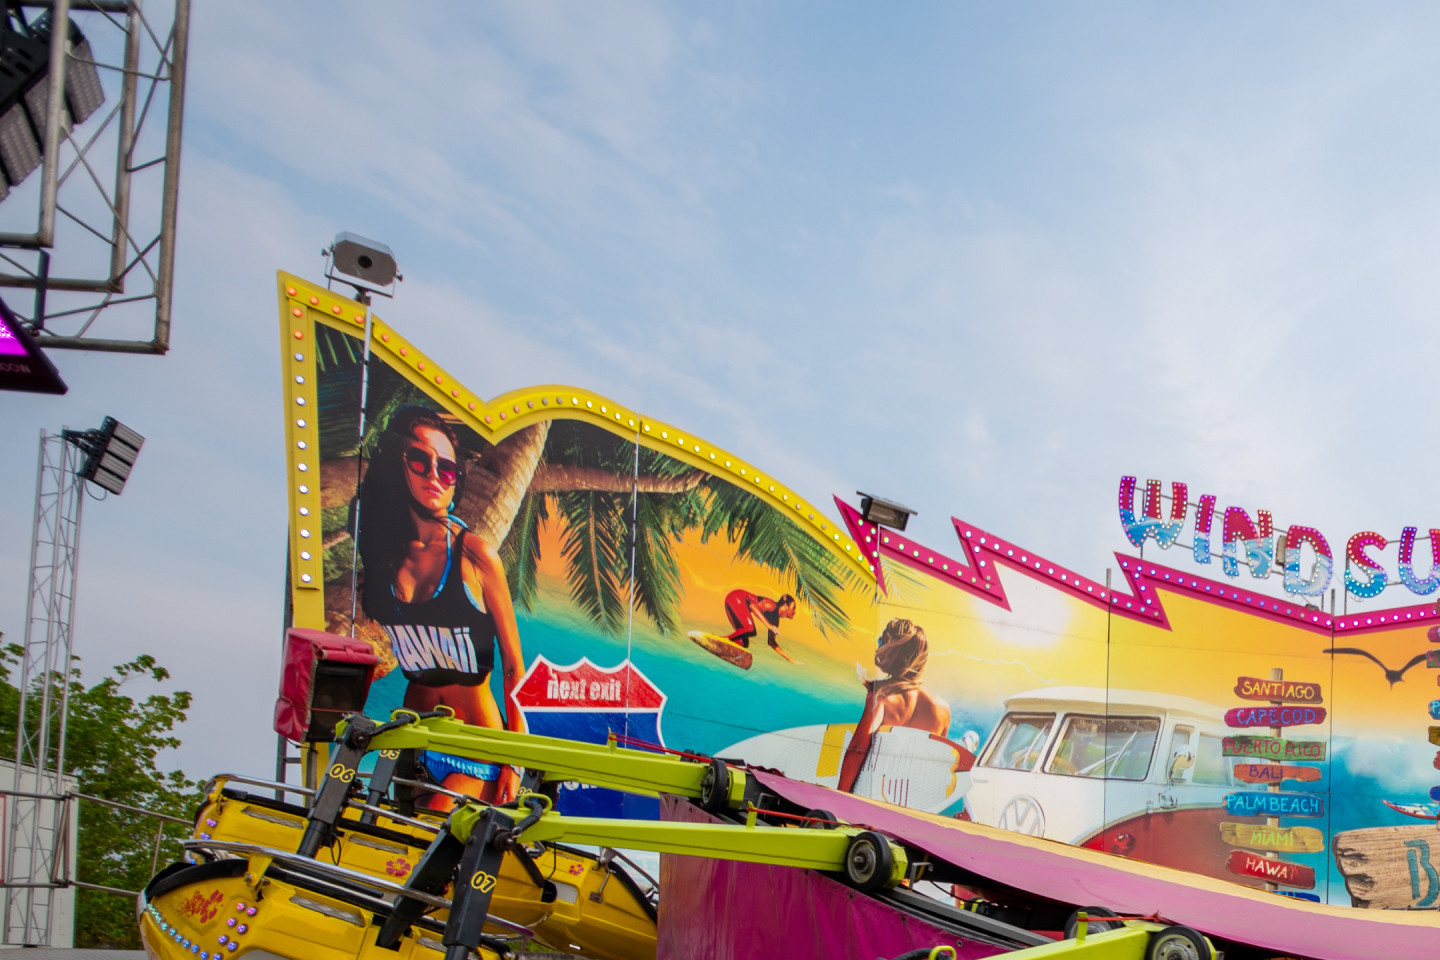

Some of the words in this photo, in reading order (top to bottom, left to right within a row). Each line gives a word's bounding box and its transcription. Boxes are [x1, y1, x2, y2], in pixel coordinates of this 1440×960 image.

[547, 678, 587, 700] next
[589, 678, 622, 701] exit
[1241, 680, 1316, 700] SANTIAGO
[1223, 737, 1281, 755] PUERTO
[1284, 741, 1321, 758] RICO
[329, 763, 356, 783] 06
[1249, 765, 1283, 780] BALI
[1226, 794, 1266, 810] PALM
[1268, 797, 1319, 813] BEACH
[471, 870, 497, 893] 07
